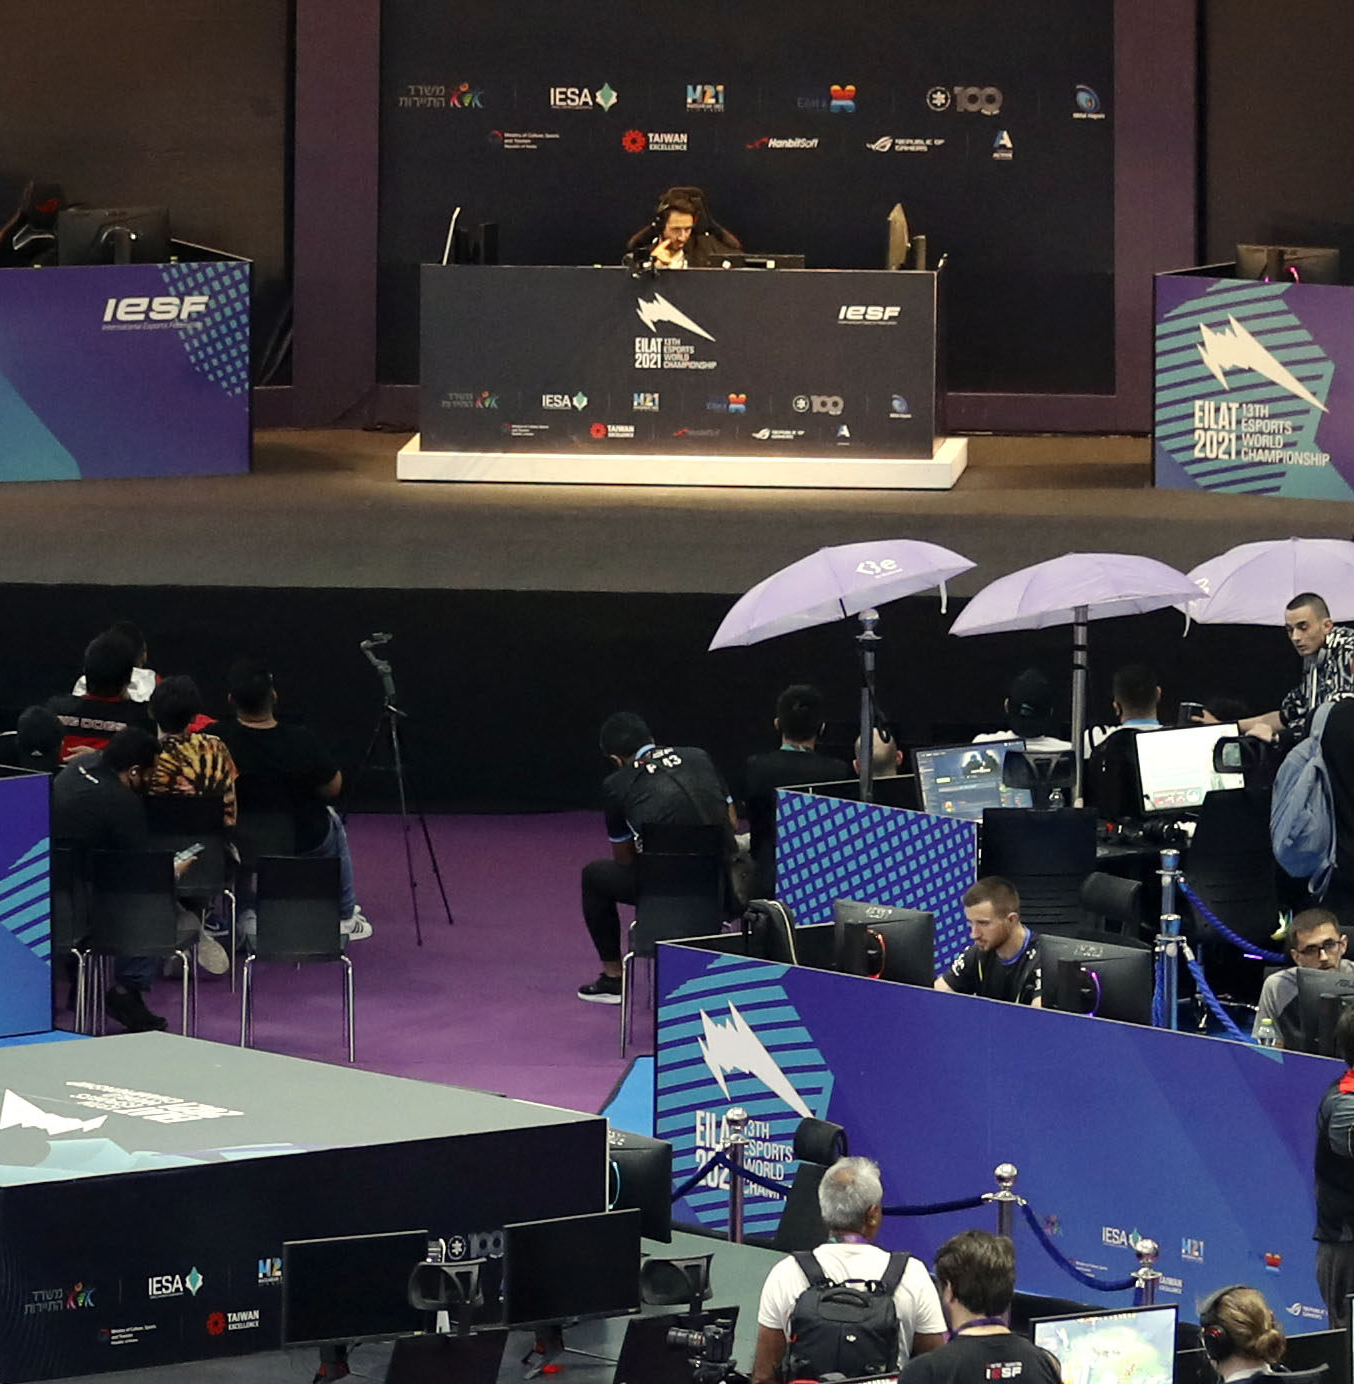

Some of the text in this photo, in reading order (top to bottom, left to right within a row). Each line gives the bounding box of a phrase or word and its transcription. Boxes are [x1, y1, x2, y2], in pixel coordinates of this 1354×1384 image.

[549, 87, 593, 106] IESA
[647, 133, 688, 144] TAIWAN
[634, 336, 664, 354] EILAT
[634, 353, 663, 369] 2021
[541, 394, 573, 408] IESA
[1192, 399, 1270, 430] EILAT 13TH
[1241, 418, 1293, 436] ESPORTS
[1192, 428, 1284, 461] 2021 WORLD
[1241, 447, 1331, 467] CHAMPIONSHIP
[1101, 1226, 1128, 1246] IESA
[148, 1274, 183, 1296] IESA
[226, 1310, 260, 1323] TAIWAN
